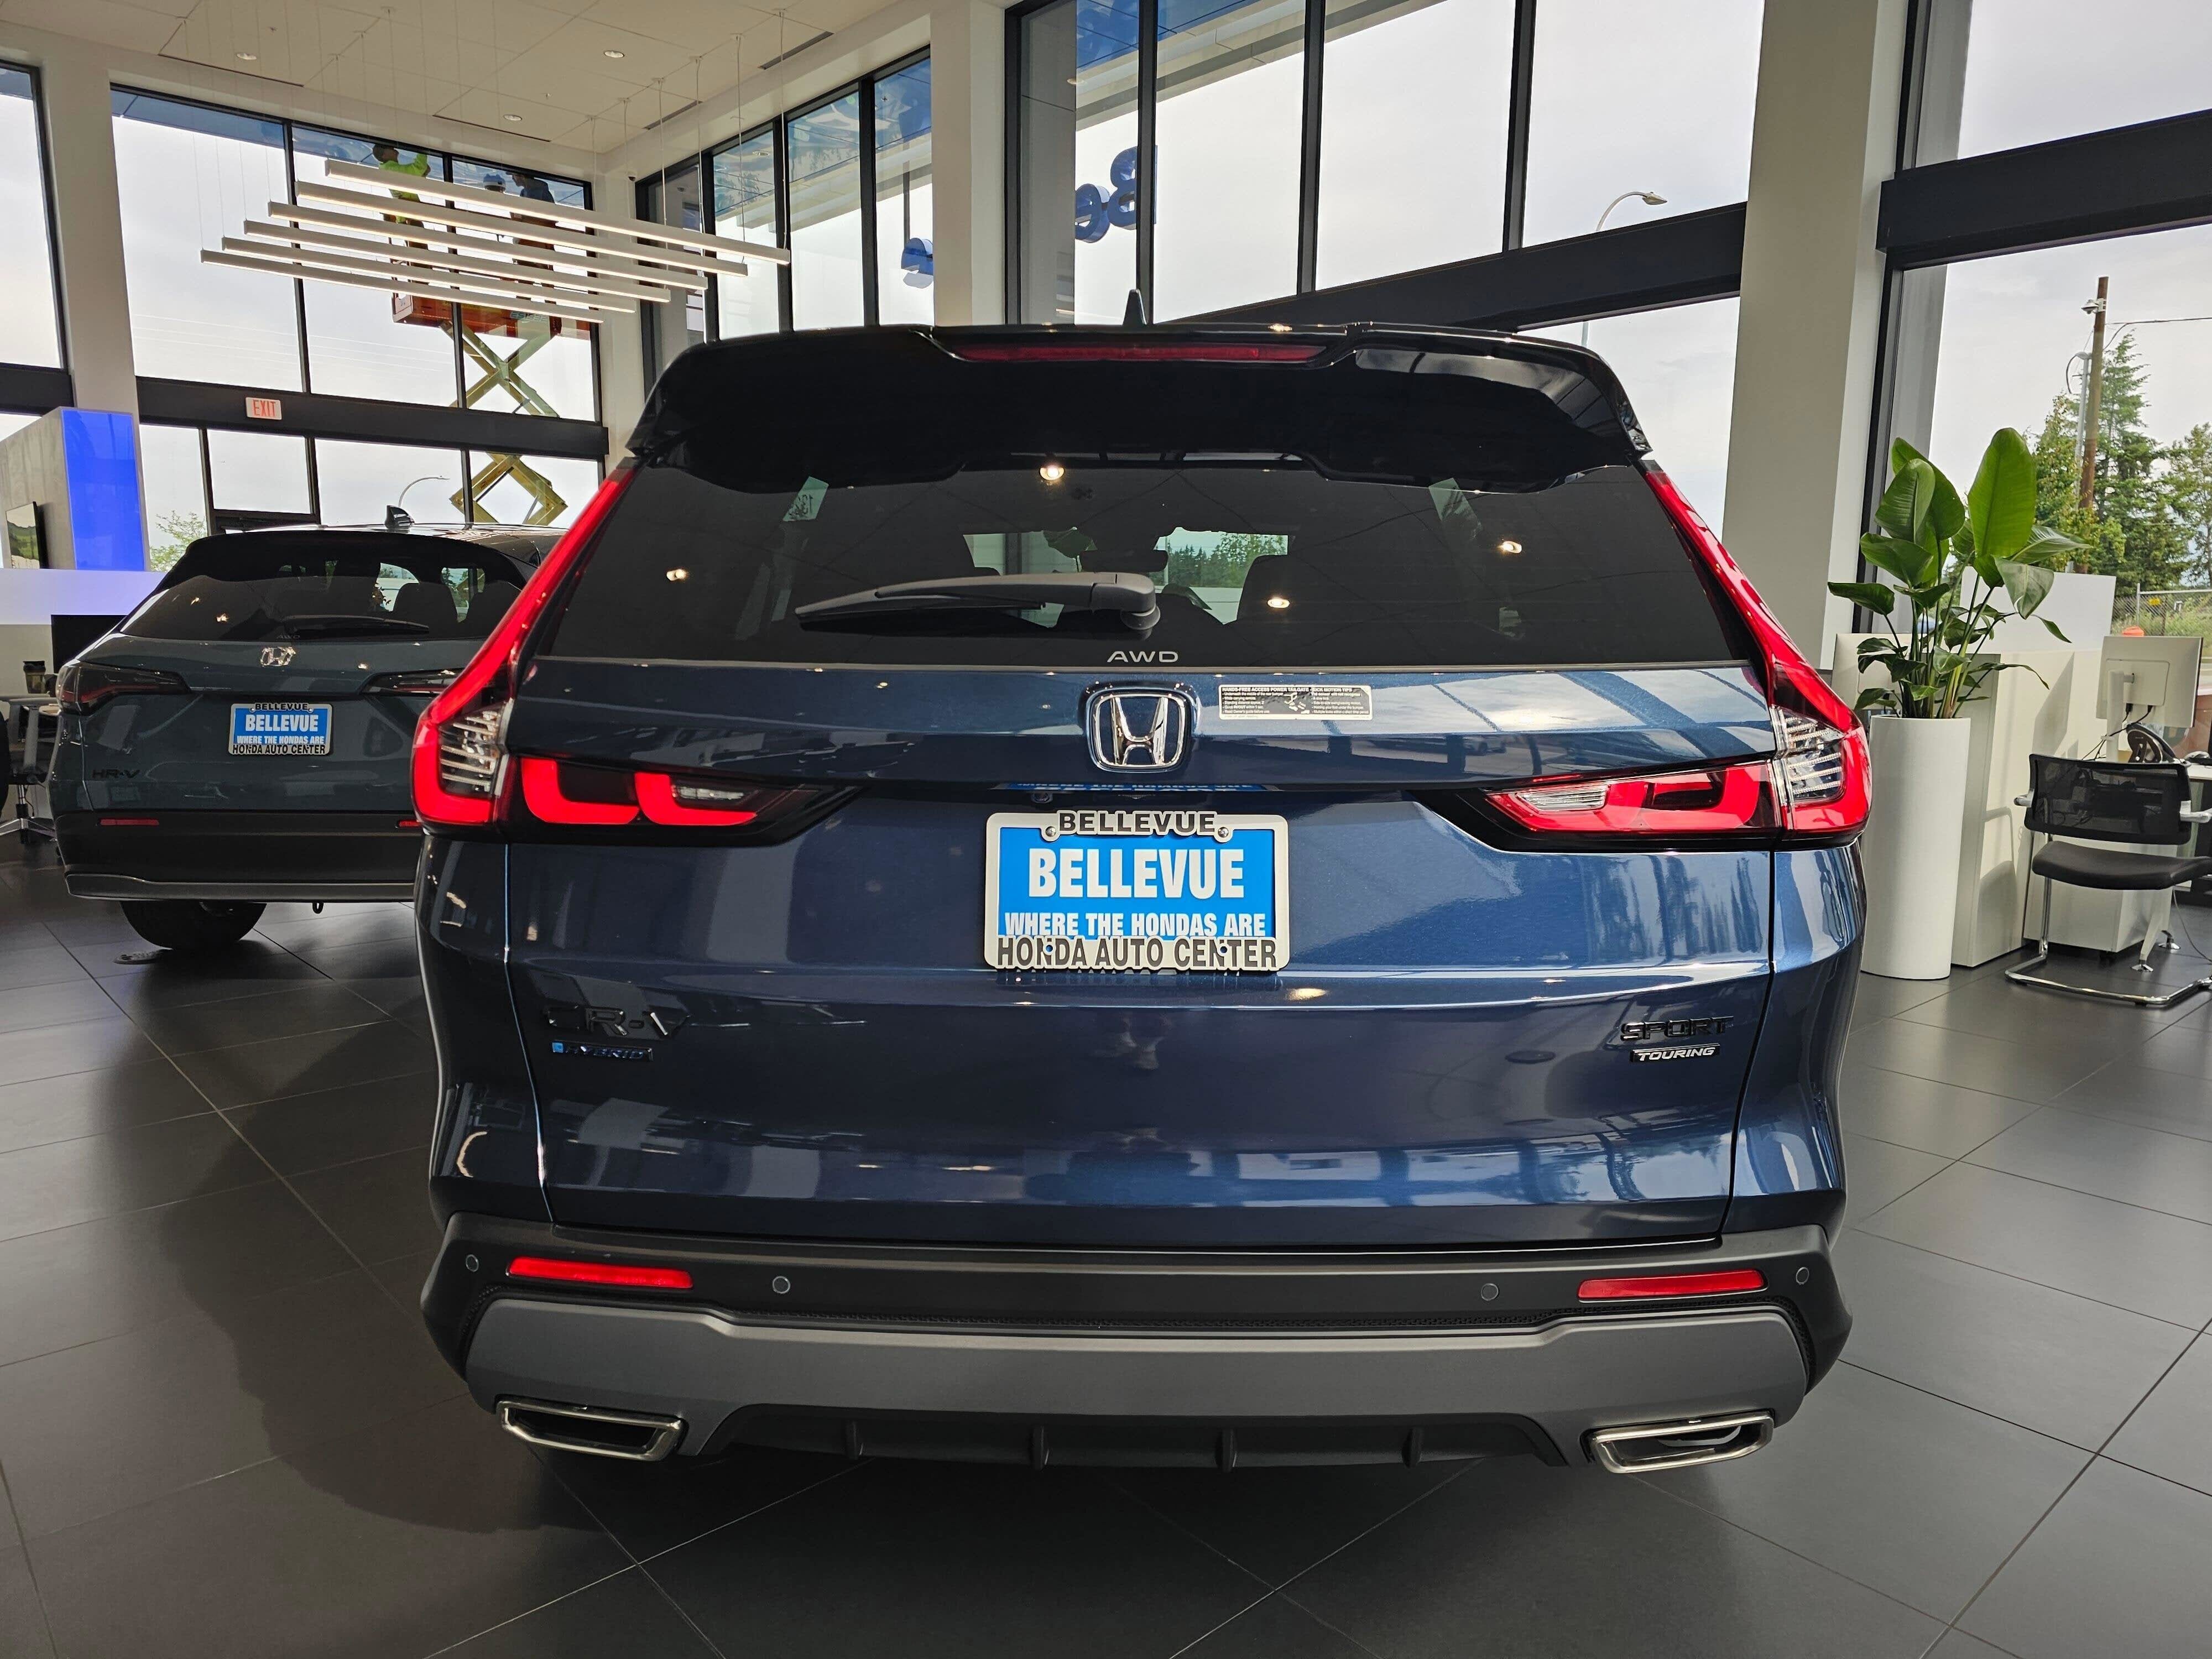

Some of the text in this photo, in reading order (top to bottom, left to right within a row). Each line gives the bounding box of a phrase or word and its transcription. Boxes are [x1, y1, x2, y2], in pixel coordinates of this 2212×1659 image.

[252, 399, 276, 417] EXIT
[1107, 651, 1178, 663] AWD
[246, 714, 319, 732] BELLEVUE
[237, 735, 262, 744] WHERE
[264, 735, 277, 744] THE
[279, 735, 308, 744] HONDAS
[233, 744, 325, 754] HONDA AUTO CENTER
[92, 769, 140, 779] HR-V
[1059, 813, 1215, 833] BELLEVUE
[1029, 848, 1244, 899] BELLEVUE
[1005, 912, 1265, 936] WHERE THE HONDAS ARE
[998, 937, 1276, 968] HONDA AUTO CENTER
[1620, 1016, 1734, 1041] SPORT
[1638, 1047, 1715, 1061] TOURING
